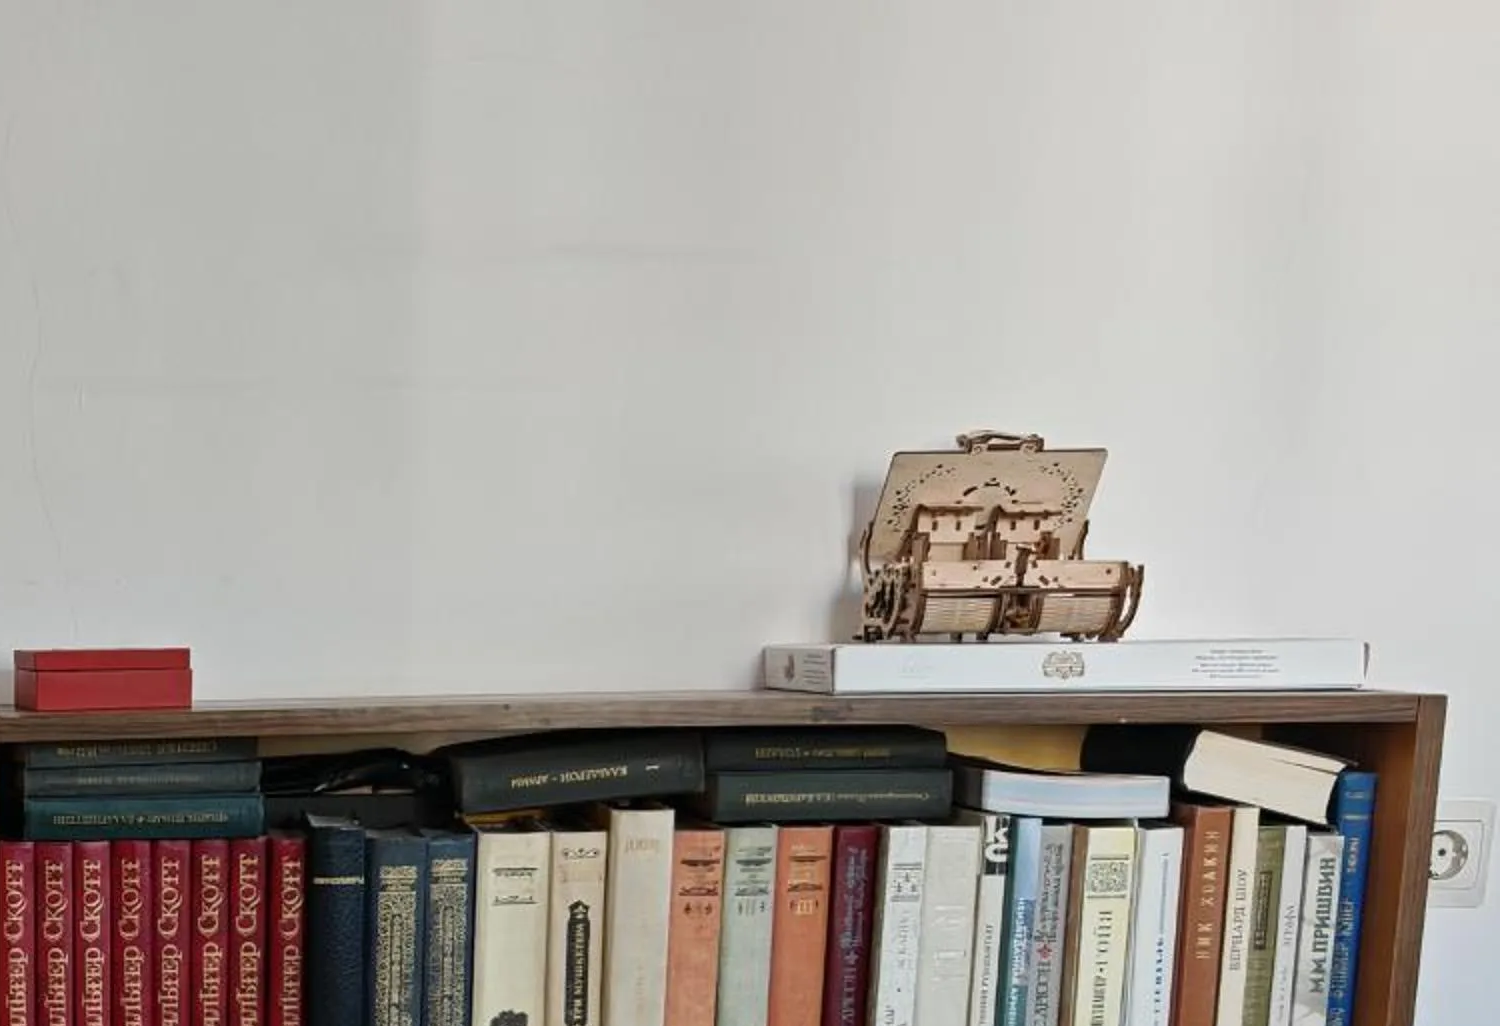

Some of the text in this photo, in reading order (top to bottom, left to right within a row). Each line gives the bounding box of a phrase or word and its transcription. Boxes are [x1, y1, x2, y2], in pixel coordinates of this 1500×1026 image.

[1196, 830, 1218, 960] НИК ХОАКИН
[1229, 868, 1247, 971] БЕРНАРД ШОУ
